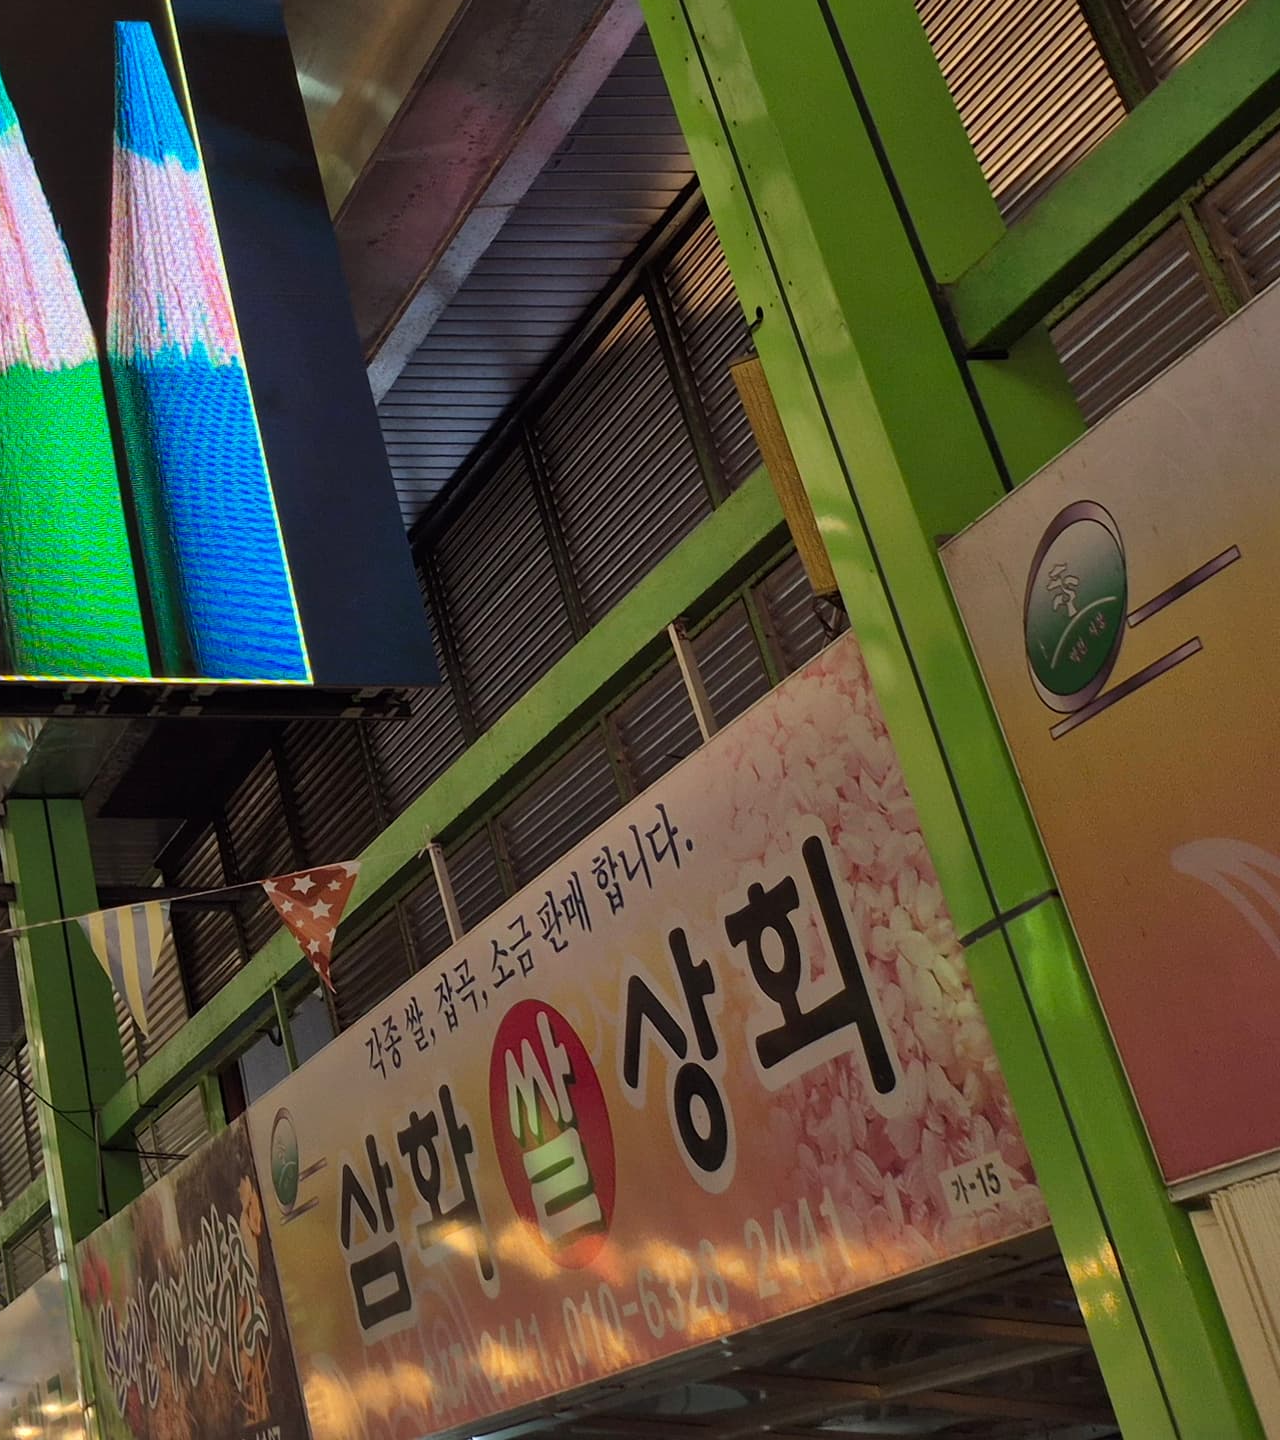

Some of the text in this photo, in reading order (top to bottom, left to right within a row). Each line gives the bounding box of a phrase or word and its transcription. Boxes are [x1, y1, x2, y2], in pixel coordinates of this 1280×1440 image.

[364, 802, 695, 1080] 각종 쌀, 잡곡, 소금 판매 합니다.
[338, 835, 897, 1330] 삼화 쌀 상회
[951, 1162, 1001, 1205] 가-15
